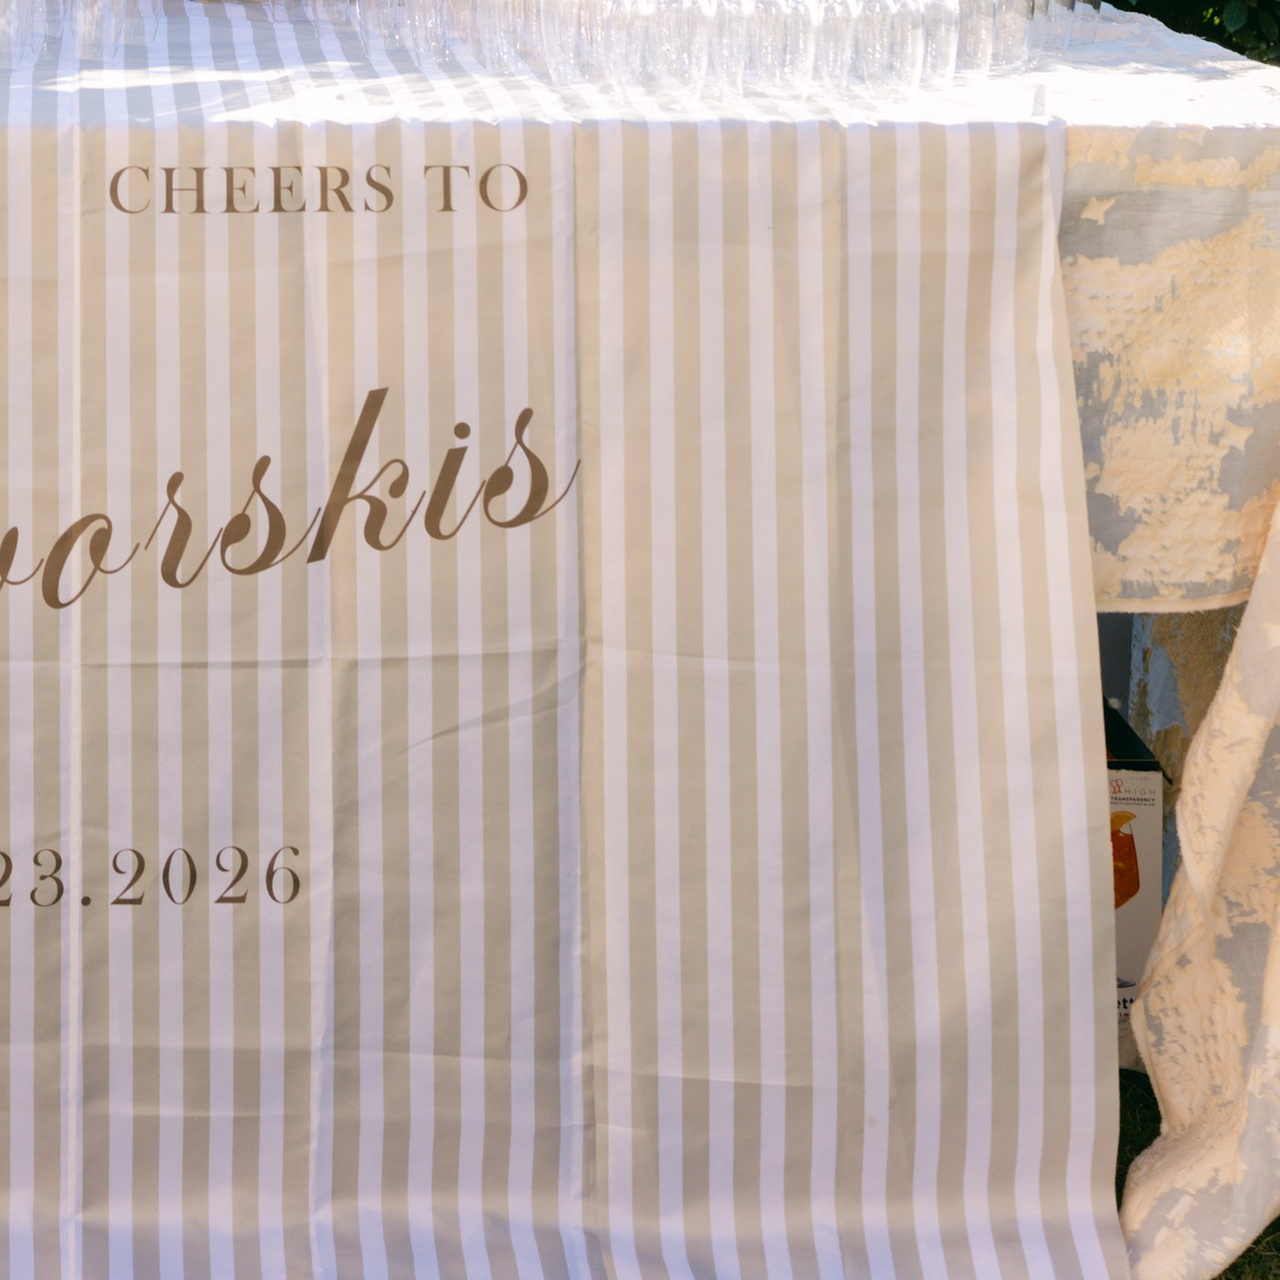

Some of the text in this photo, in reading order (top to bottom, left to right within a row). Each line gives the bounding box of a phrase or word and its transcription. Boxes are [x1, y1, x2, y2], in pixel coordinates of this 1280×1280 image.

[108, 163, 529, 215] CHEERS TO
[1124, 788, 1156, 796] HIGH
